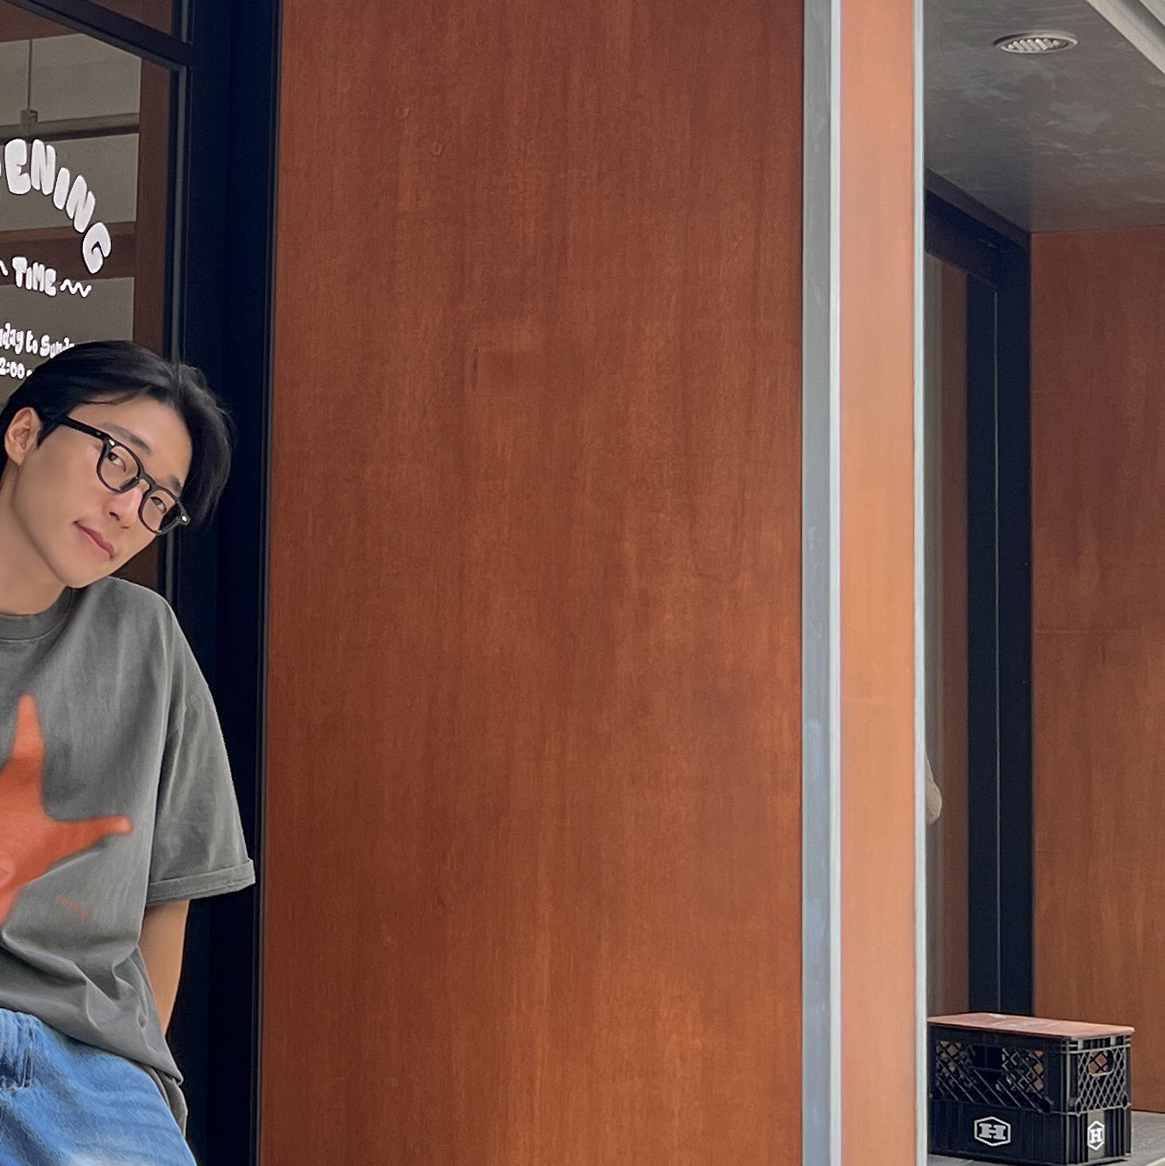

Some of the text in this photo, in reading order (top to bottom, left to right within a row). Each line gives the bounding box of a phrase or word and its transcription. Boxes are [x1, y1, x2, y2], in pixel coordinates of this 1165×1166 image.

[26, 330, 38, 354] to
[979, 1123, 1006, 1140] H
[1089, 1128, 1103, 1143] H
